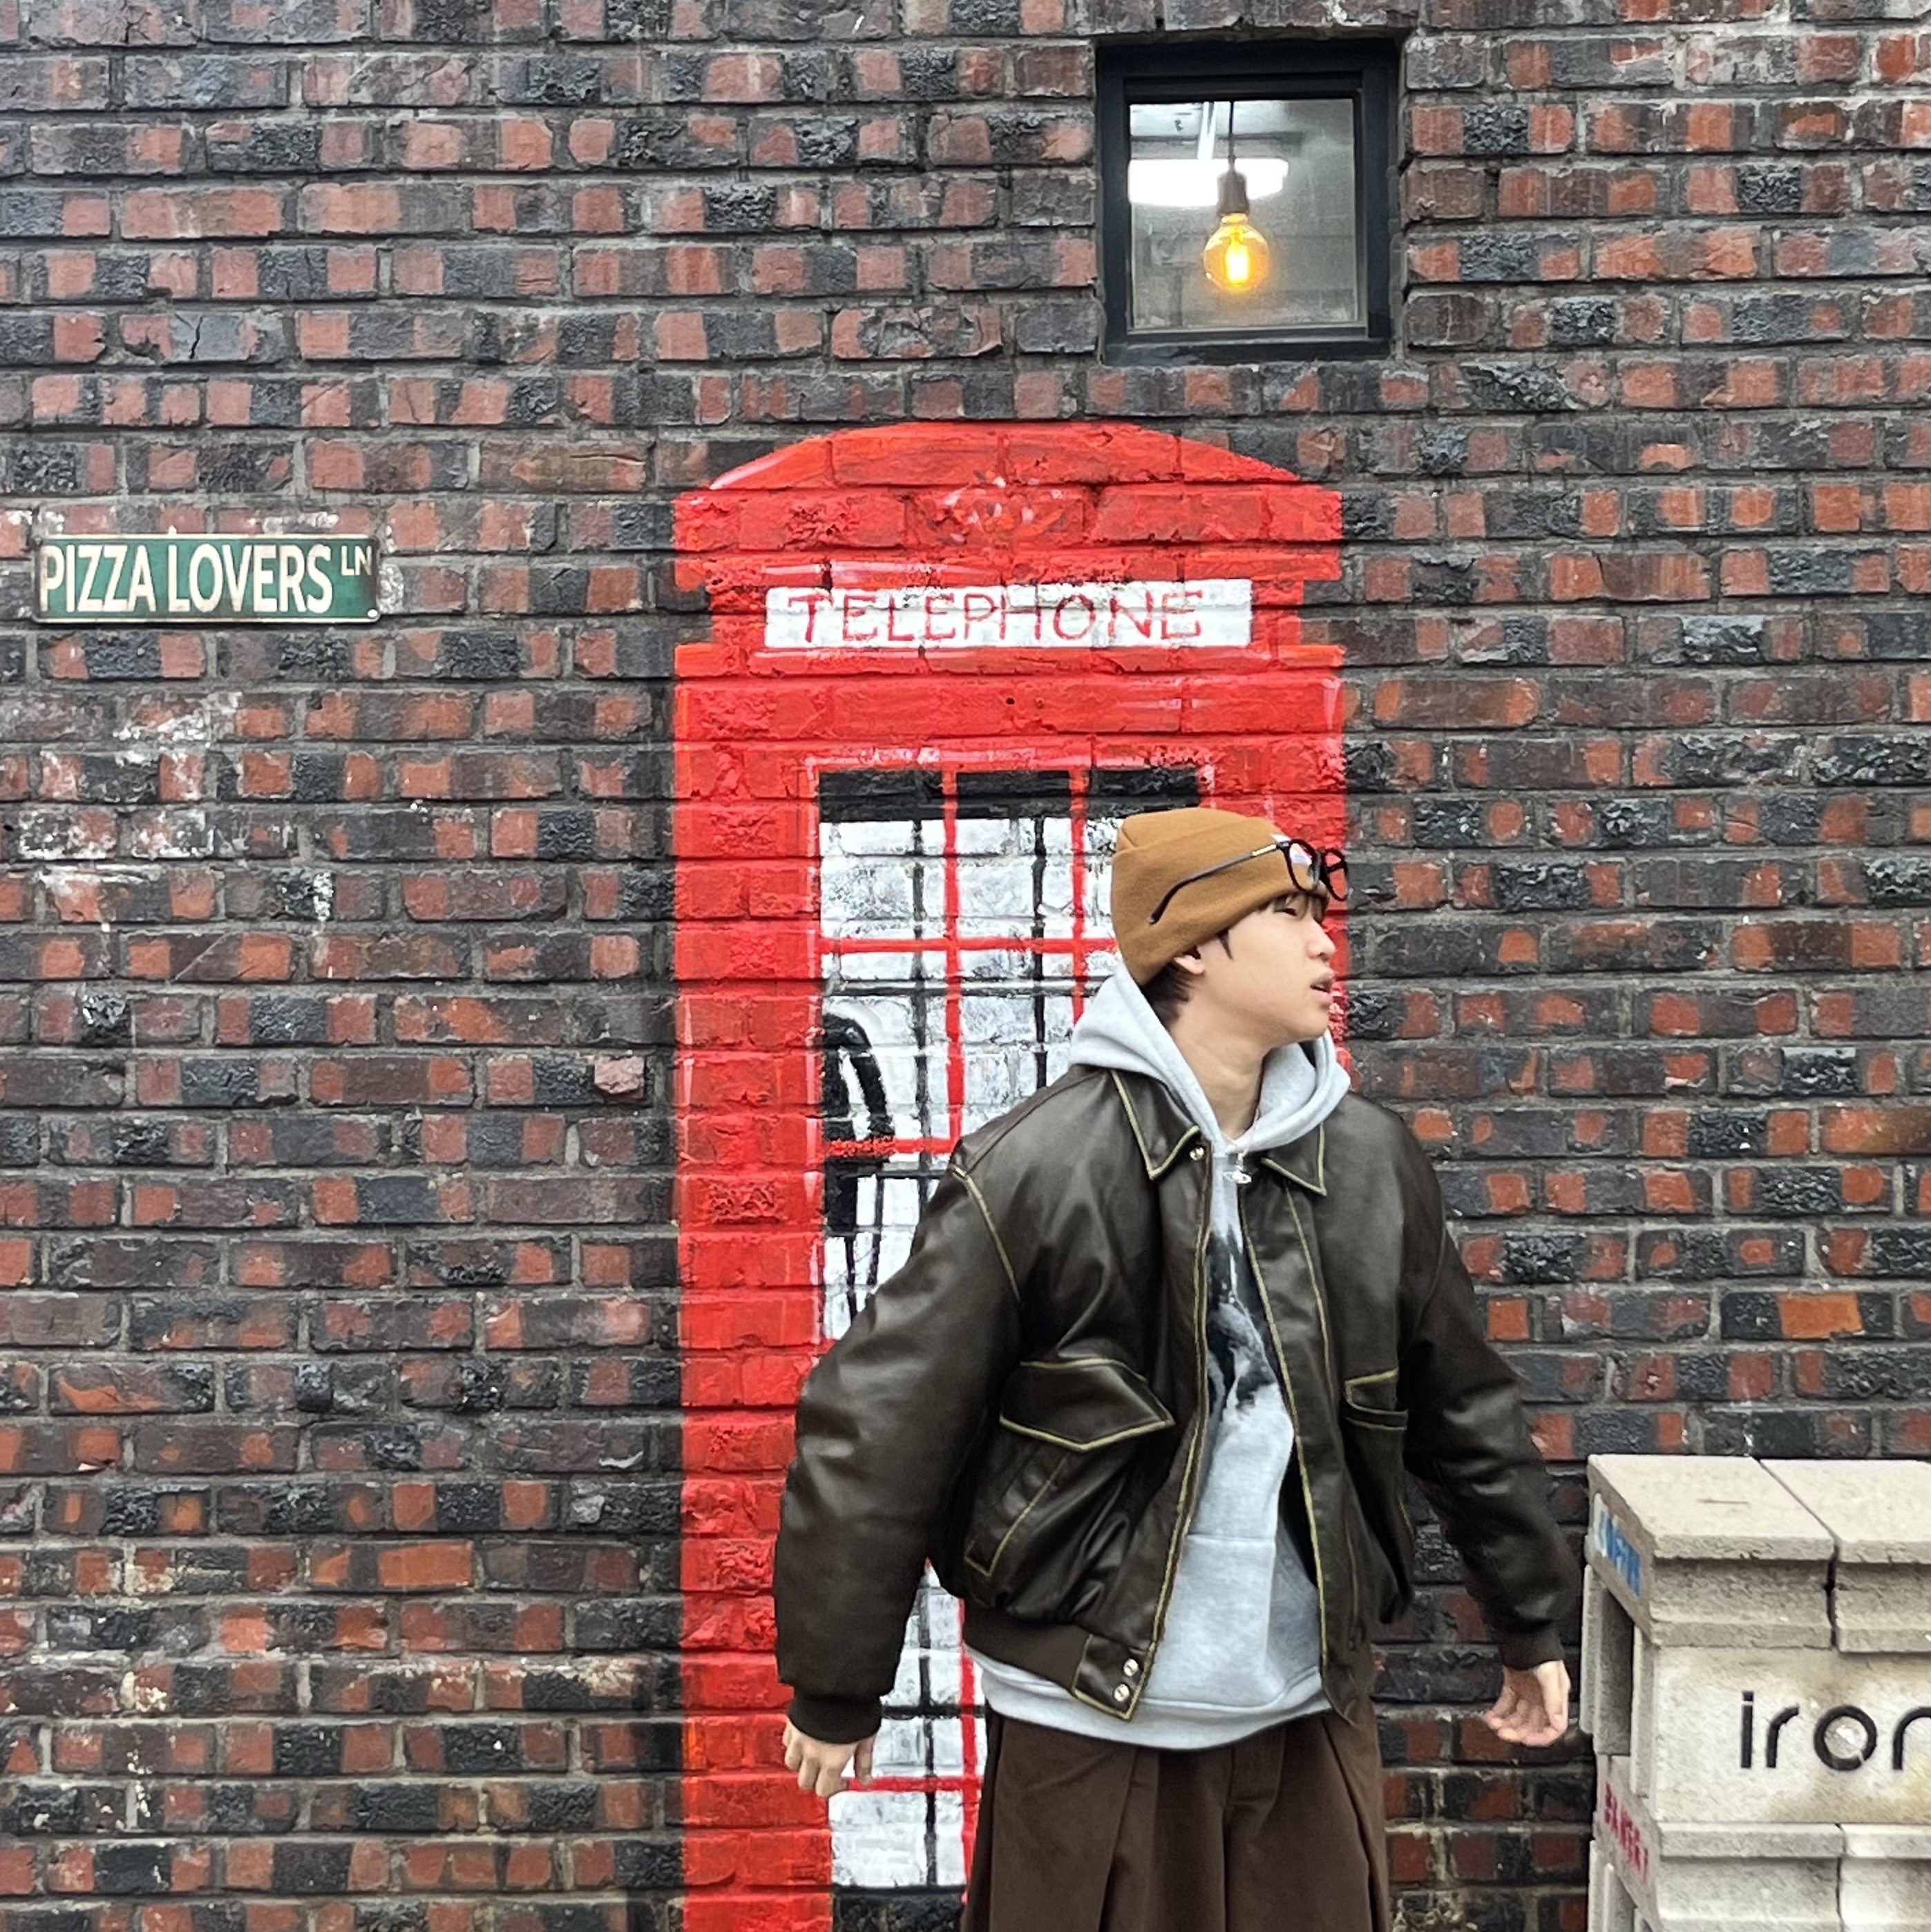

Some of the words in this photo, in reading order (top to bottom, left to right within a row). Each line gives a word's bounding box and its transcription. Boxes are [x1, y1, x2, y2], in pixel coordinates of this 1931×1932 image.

[40, 543, 156, 613] PIZZA
[168, 543, 333, 614] LOVERS
[341, 545, 372, 576] LN
[788, 589, 1204, 643] TELEPHONE
